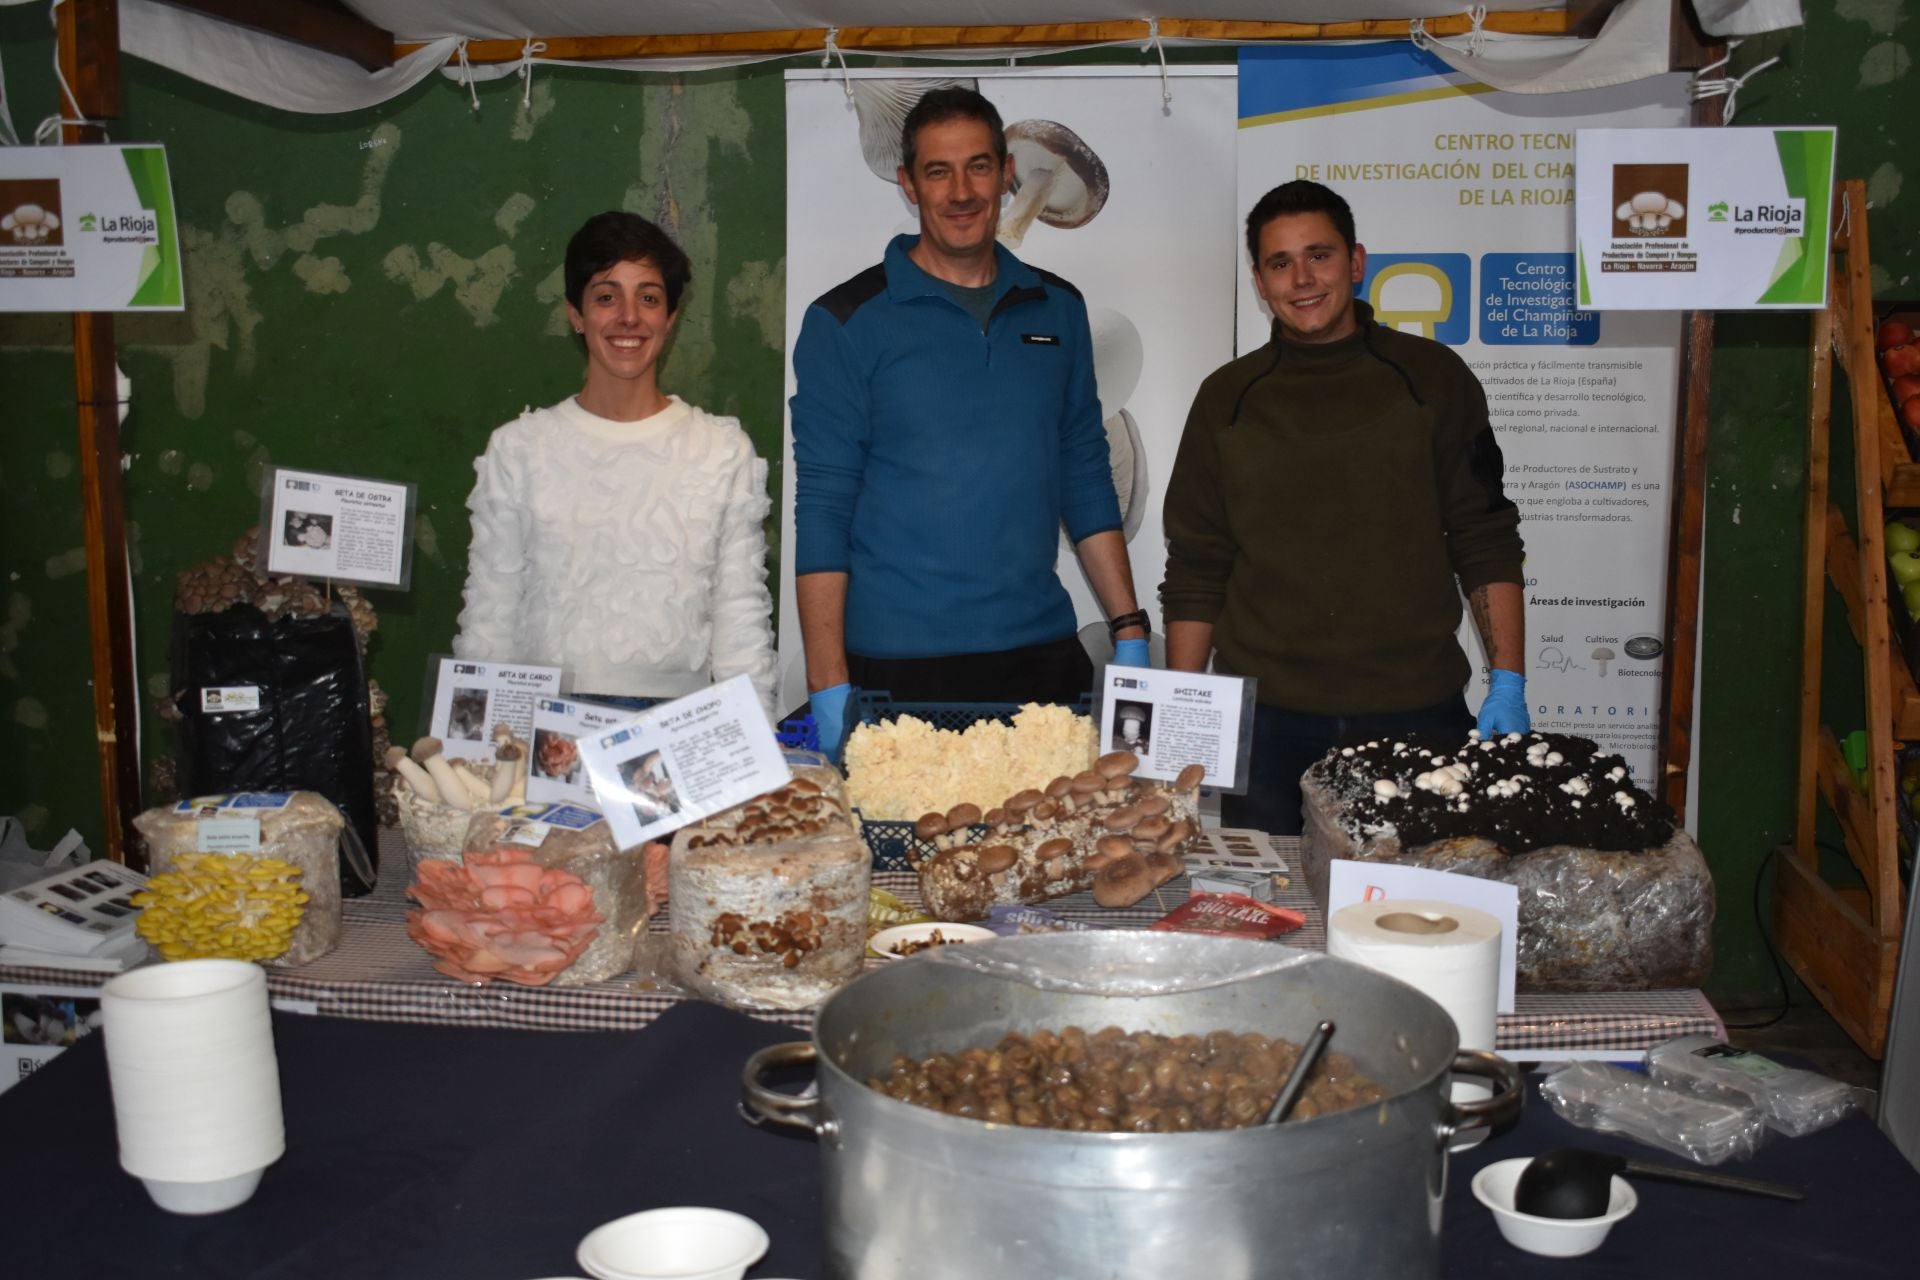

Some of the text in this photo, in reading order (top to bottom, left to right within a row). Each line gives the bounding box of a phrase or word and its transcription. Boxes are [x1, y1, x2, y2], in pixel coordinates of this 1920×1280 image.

[1434, 133, 1576, 150] CENTRO TECN
[1295, 164, 1320, 180] DE
[1327, 159, 1480, 180] INVESTIGACIÓN
[1492, 163, 1528, 179] DEL
[1459, 189, 1575, 205] DE LA RIOJA
[1734, 204, 1801, 225] La Rioja
[101, 216, 155, 234] La Rioja
[1645, 242, 1679, 250] Profesional
[1681, 242, 1689, 250] de
[1515, 262, 1566, 275] Centro
[1613, 262, 1630, 272] Rioja
[1638, 262, 1663, 271] Navarra
[1670, 262, 1695, 272] Aragón
[1486, 293, 1503, 306] de
[1487, 309, 1508, 321] del
[1501, 324, 1578, 340] de La Rioja
[1493, 361, 1528, 371] práctica
[1530, 363, 1536, 372] y
[1537, 361, 1585, 371] fácilmente
[1588, 361, 1643, 370] transmisible
[1480, 376, 1616, 388] cultivados de La Rioja (España)
[1495, 392, 1534, 401] científica
[1537, 394, 1542, 403] y
[1544, 392, 1590, 402] desarrollo
[1592, 392, 1646, 404] tecnológico,
[1517, 409, 1541, 417] como
[1544, 408, 1581, 418] privada.
[1509, 424, 1548, 434] regional,
[1550, 424, 1588, 433] nacional
[1598, 424, 1660, 434] internacional.
[1509, 464, 1520, 473] de
[1523, 464, 1577, 474] Productores
[1579, 464, 1590, 474] de
[1593, 464, 1630, 474] Sustrato
[1632, 467, 1638, 475] y
[1521, 482, 1527, 491] y
[1529, 480, 1560, 491] Aragón
[1565, 480, 1627, 491] (ASOCHAMP)
[1632, 482, 1641, 490] es
[1644, 482, 1660, 490] una
[356, 491, 365, 499] DE
[1527, 498, 1543, 507] que
[1546, 497, 1582, 507] engloba
[1592, 497, 1649, 508] cultivadores,
[1556, 513, 1633, 523] transformadoras.
[1530, 595, 1645, 609] Áreas de investigación
[1541, 634, 1619, 644] Salud Cultivos
[518, 672, 527, 680] DE
[530, 673, 552, 682] CARDO
[1173, 688, 1212, 698] SHIITAKE
[682, 710, 693, 719] DE
[1573, 722, 1595, 730] presta
[1608, 722, 1635, 730] servicio
[1191, 900, 1270, 925] SHIITAKE
